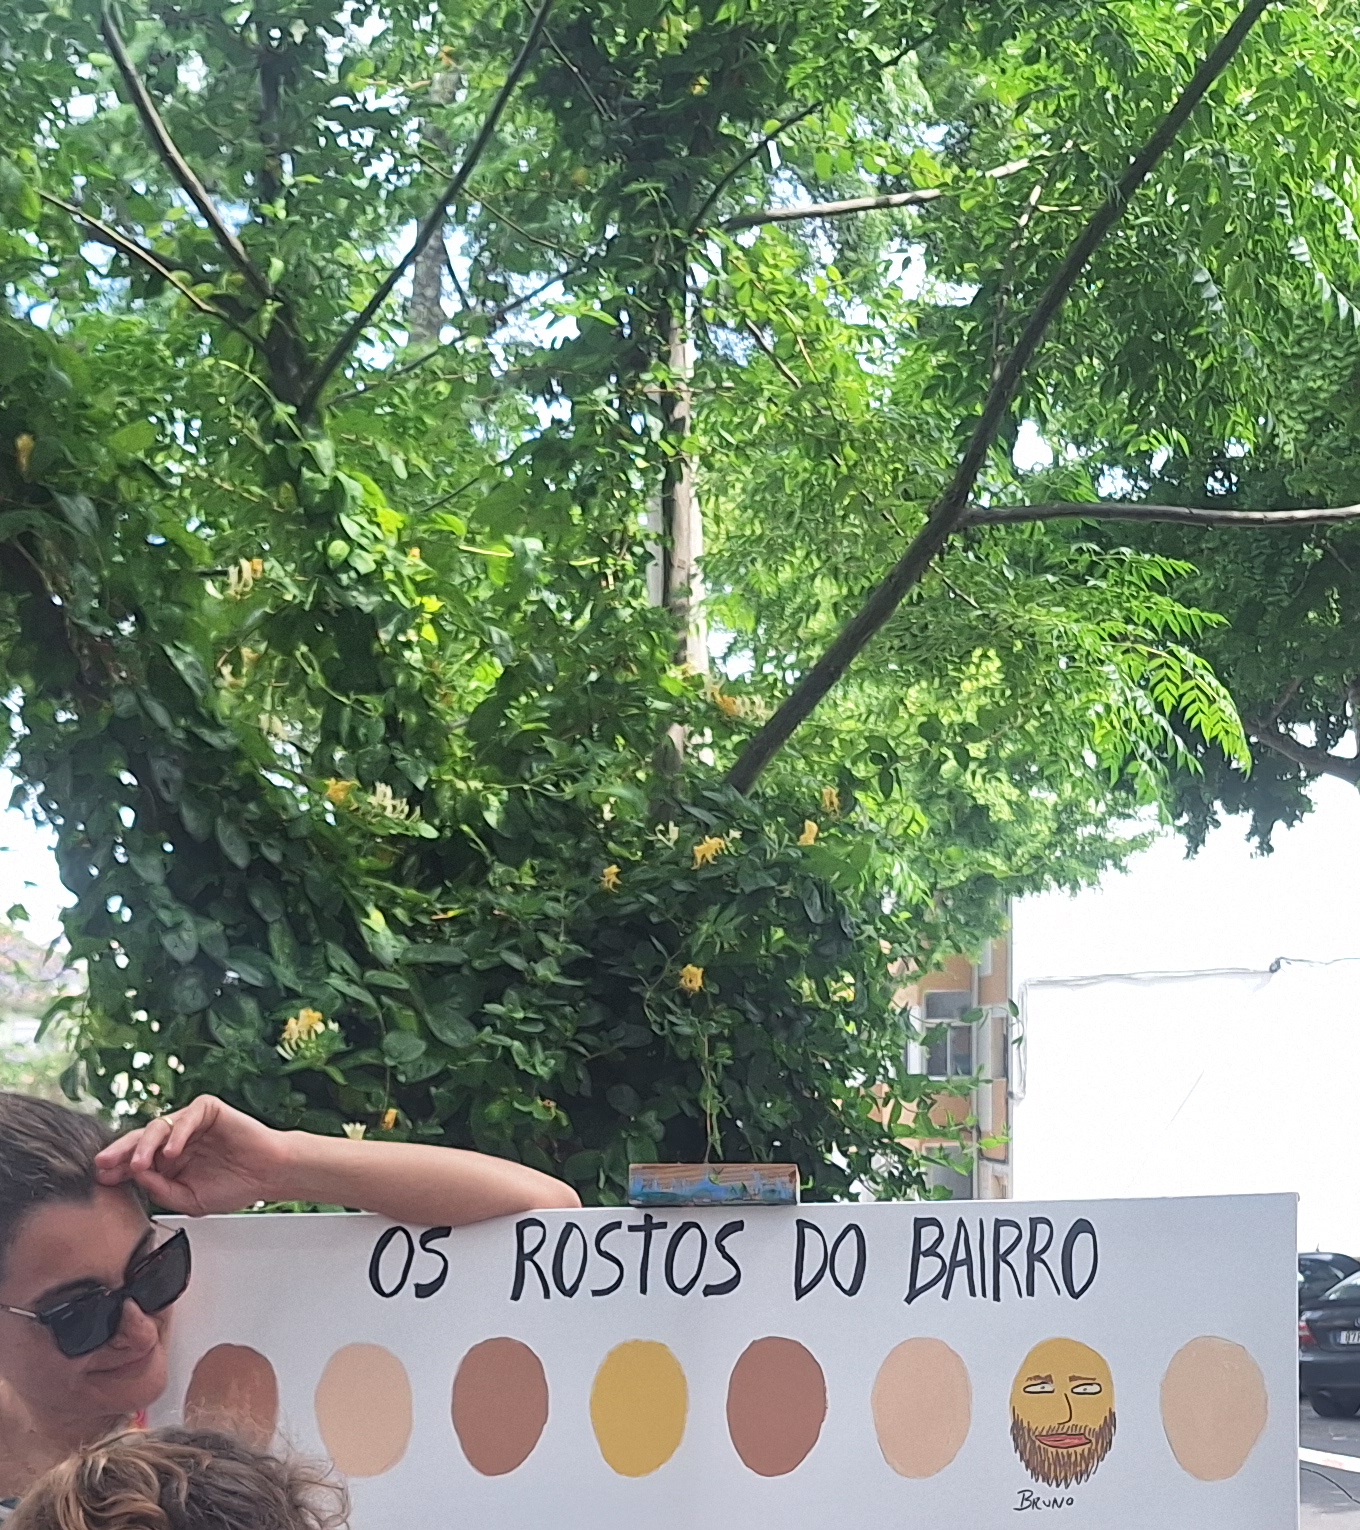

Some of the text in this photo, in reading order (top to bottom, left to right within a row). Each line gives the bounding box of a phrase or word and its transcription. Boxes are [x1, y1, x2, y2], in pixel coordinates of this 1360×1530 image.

[368, 1213, 1099, 1304] OS ROSTOS DO BAIRRO
